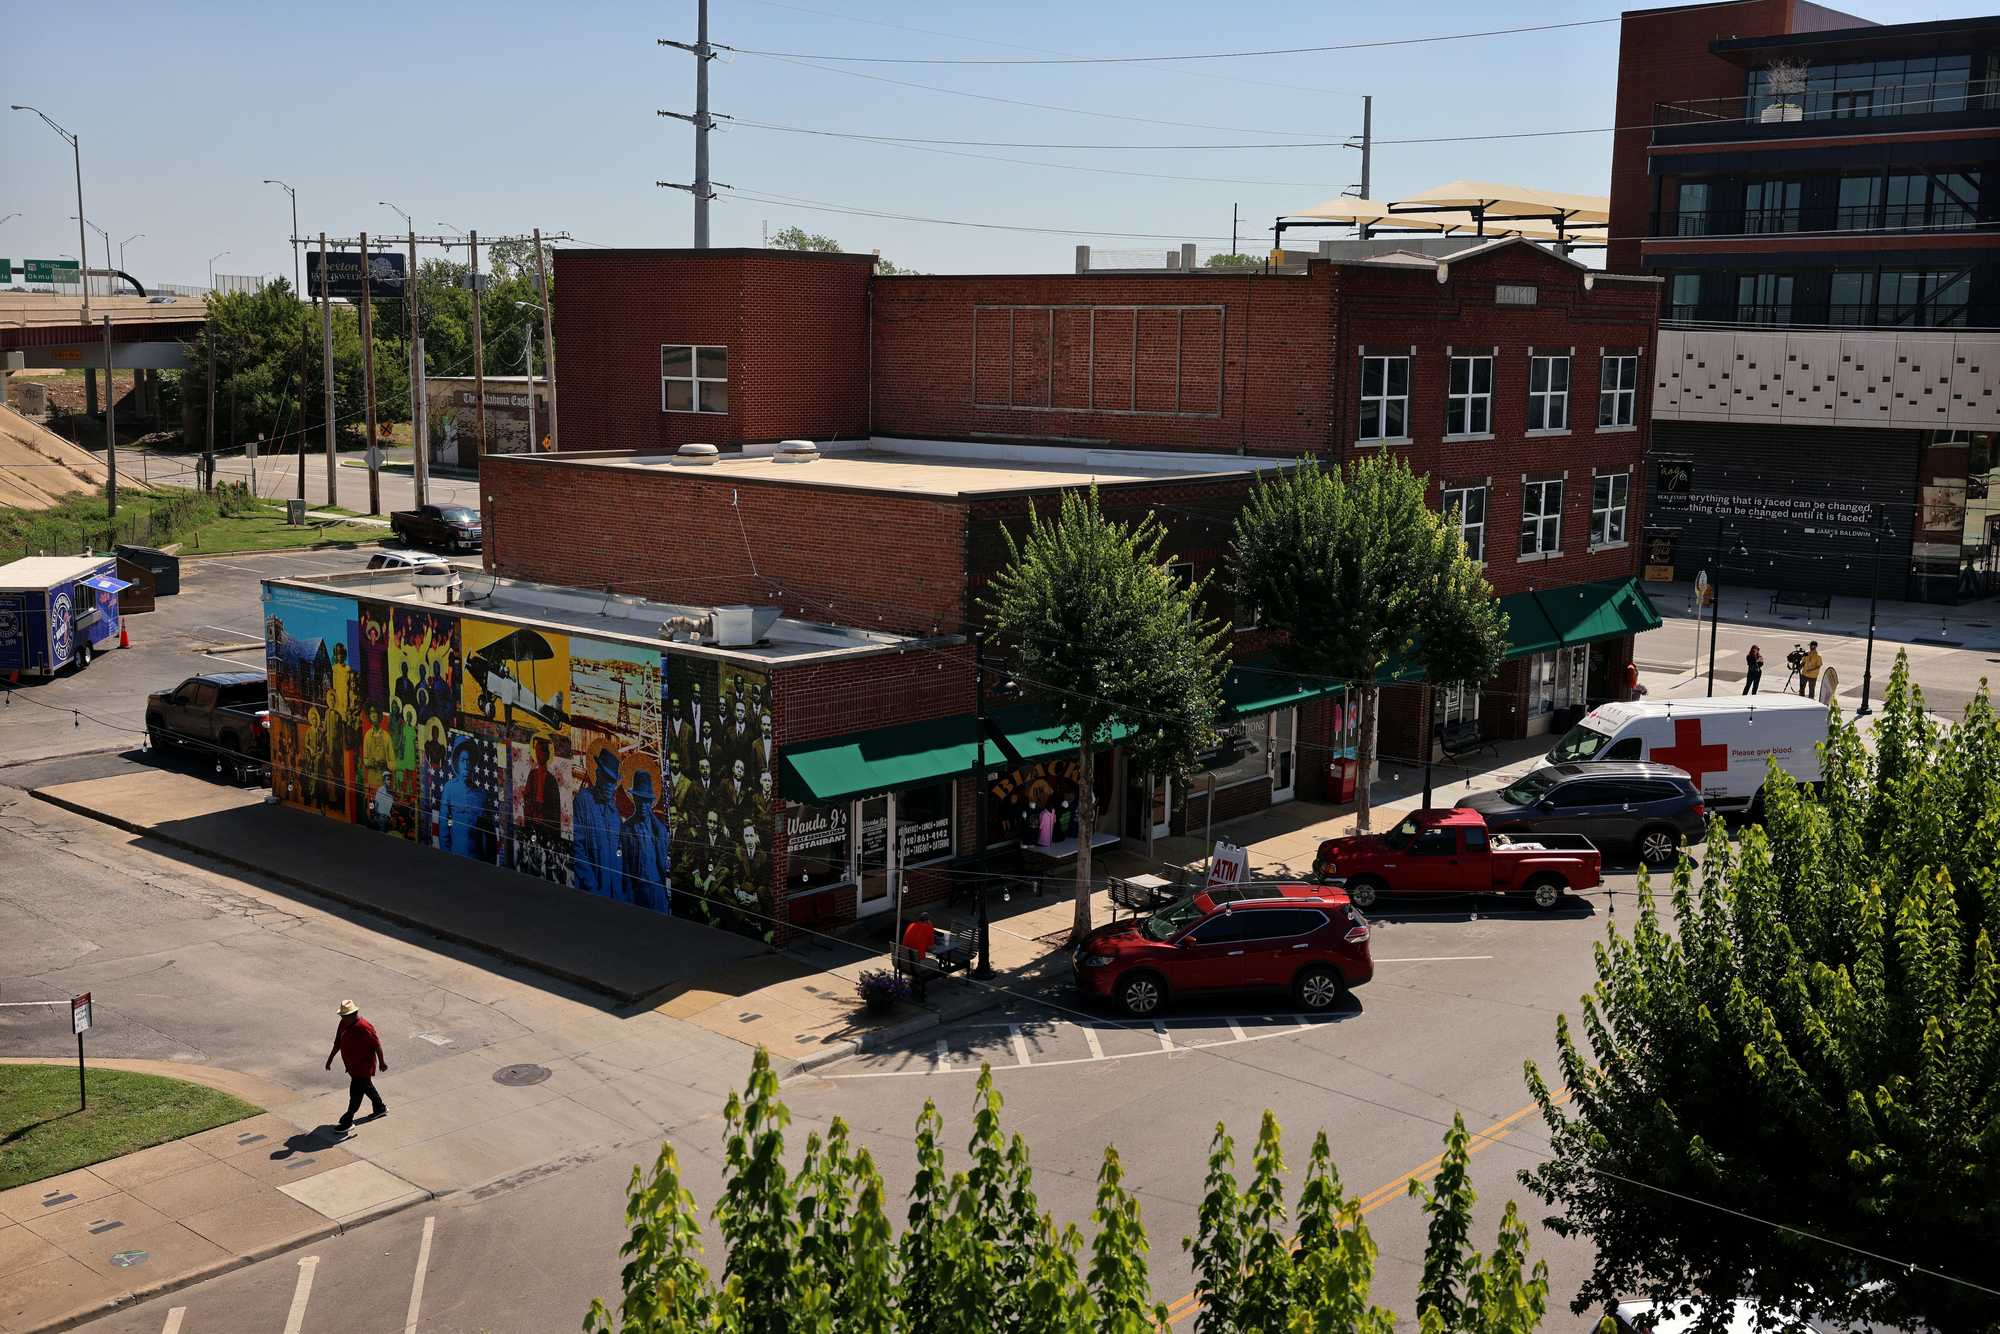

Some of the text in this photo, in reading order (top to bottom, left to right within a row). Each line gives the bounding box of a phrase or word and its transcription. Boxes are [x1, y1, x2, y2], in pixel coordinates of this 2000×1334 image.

[1688, 494, 1730, 506] erything
[1733, 496, 1752, 504] that
[1754, 496, 1762, 505] is
[1764, 498, 1791, 507] faced
[1828, 502, 1872, 513] changed,
[1734, 506, 1746, 514] be
[1748, 508, 1788, 518] changed
[1792, 510, 1813, 519] until
[1816, 512, 1824, 520] it
[1826, 512, 1834, 520] is
[1228, 720, 1265, 737] OLUTIONS
[1732, 749, 1755, 757] Please
[787, 808, 847, 836] Wanda J's
[787, 834, 847, 852] RESTAURANT
[903, 830, 947, 846] 18)861-4142
[1212, 858, 1238, 881] ATM
